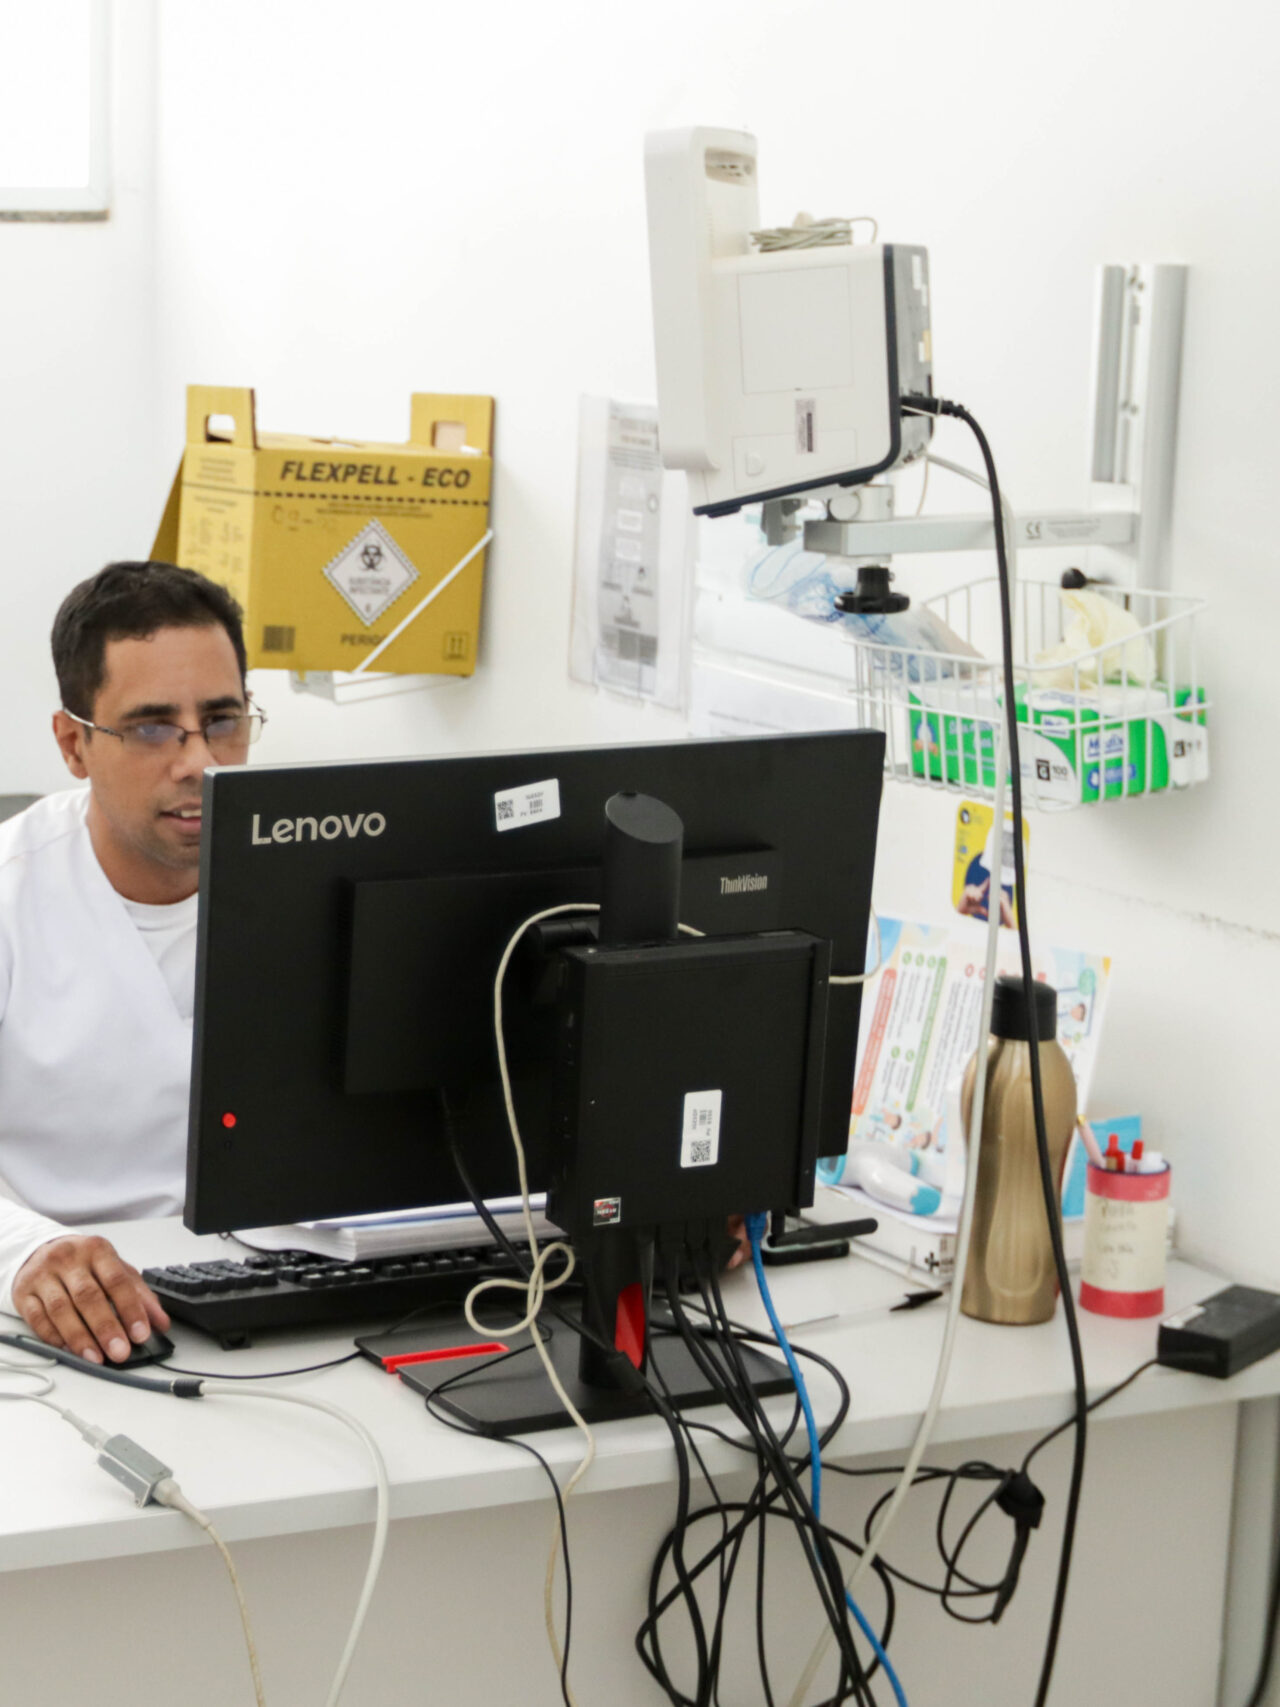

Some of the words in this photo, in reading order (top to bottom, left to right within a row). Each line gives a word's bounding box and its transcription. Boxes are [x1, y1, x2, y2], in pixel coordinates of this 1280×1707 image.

[280, 461, 400, 486] FLEXPELL
[422, 467, 472, 488] ECO
[341, 633, 388, 647] PERIG
[251, 812, 387, 845] Lenovo
[720, 873, 768, 895] ThinkVision
